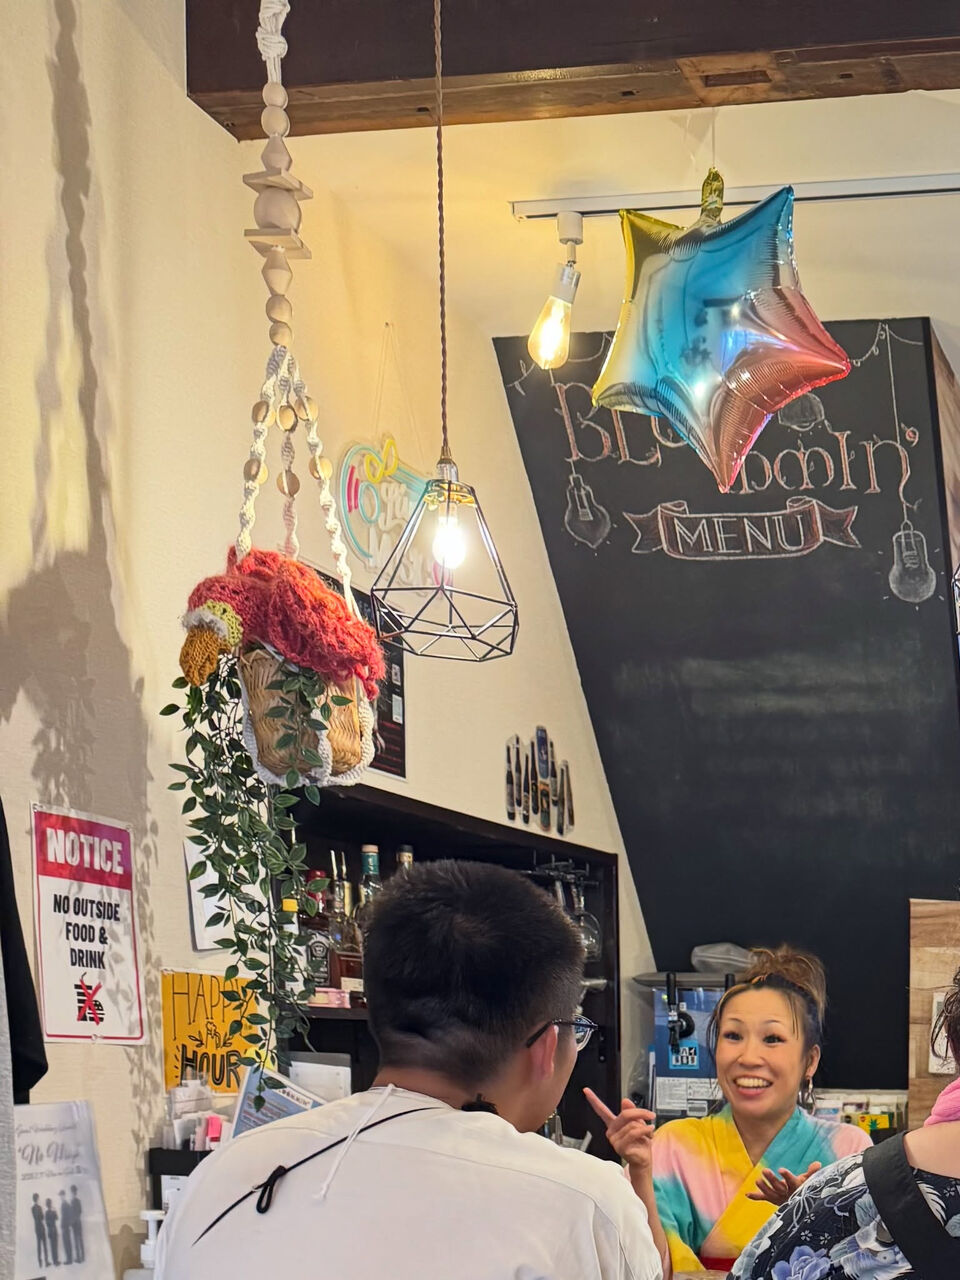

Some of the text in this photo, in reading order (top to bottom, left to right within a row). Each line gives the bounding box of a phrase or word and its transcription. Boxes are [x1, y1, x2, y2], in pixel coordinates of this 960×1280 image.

[673, 514, 804, 554] MENU
[46, 827, 124, 875] NOTICE
[53, 893, 120, 922] NO OUTSIDE
[65, 921, 108, 945] FOOD &
[70, 947, 106, 970] DRINK
[180, 1043, 241, 1089] HOUR
